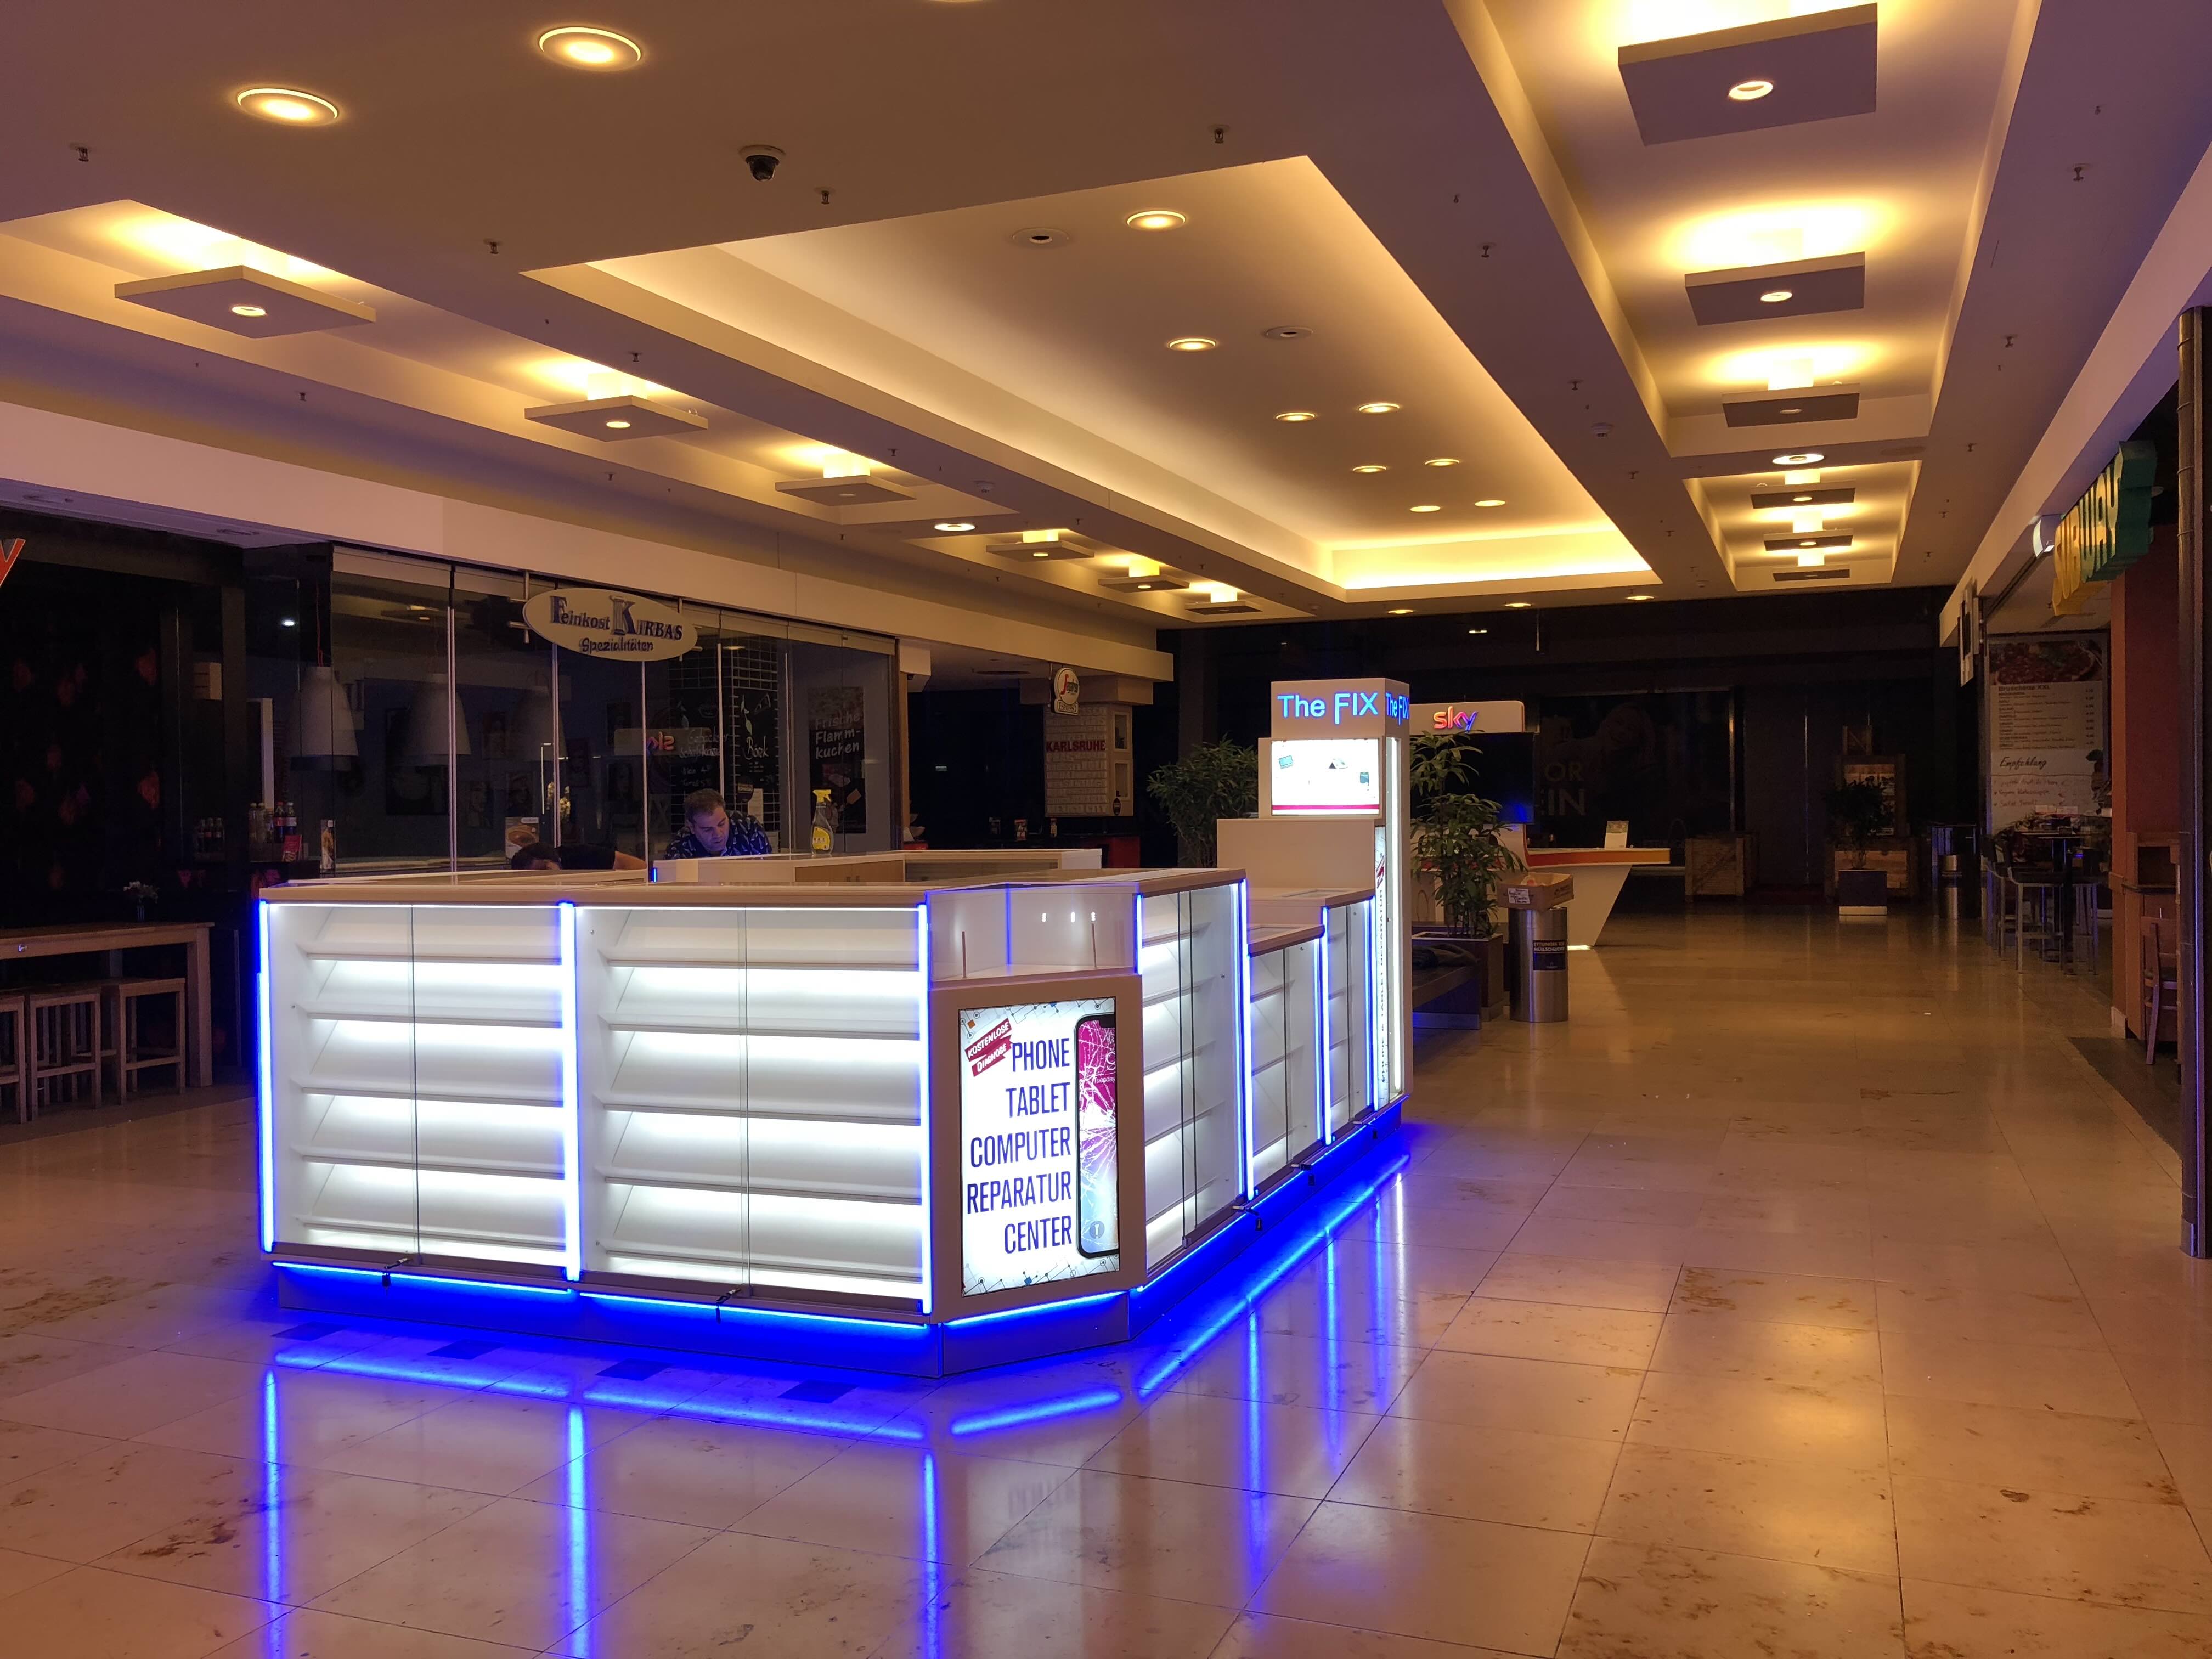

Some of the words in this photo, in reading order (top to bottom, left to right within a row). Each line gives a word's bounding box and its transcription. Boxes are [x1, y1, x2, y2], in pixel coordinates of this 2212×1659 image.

[2052, 444, 2124, 607] SUBWAY
[550, 596, 610, 630] Feinkost
[610, 595, 682, 640] KIRBAS
[580, 638, 654, 654] Spezialitäten
[1277, 695, 1325, 718] The
[1334, 692, 1379, 724] FIX
[1385, 692, 1397, 716] The
[1398, 695, 1409, 725] FIX
[1433, 706, 1478, 732] sky
[815, 742, 860, 760] kuchen
[1046, 740, 1106, 752] KARLSRUHE
[967, 1021, 1009, 1058] KOSTENLOSE
[1012, 1038, 1070, 1072] PHONE
[1005, 1082, 1070, 1118] TABLET
[970, 1126, 1071, 1169] COMPUTER
[967, 1172, 1072, 1214] REPARATUR
[1004, 1215, 1072, 1254] CENTER
